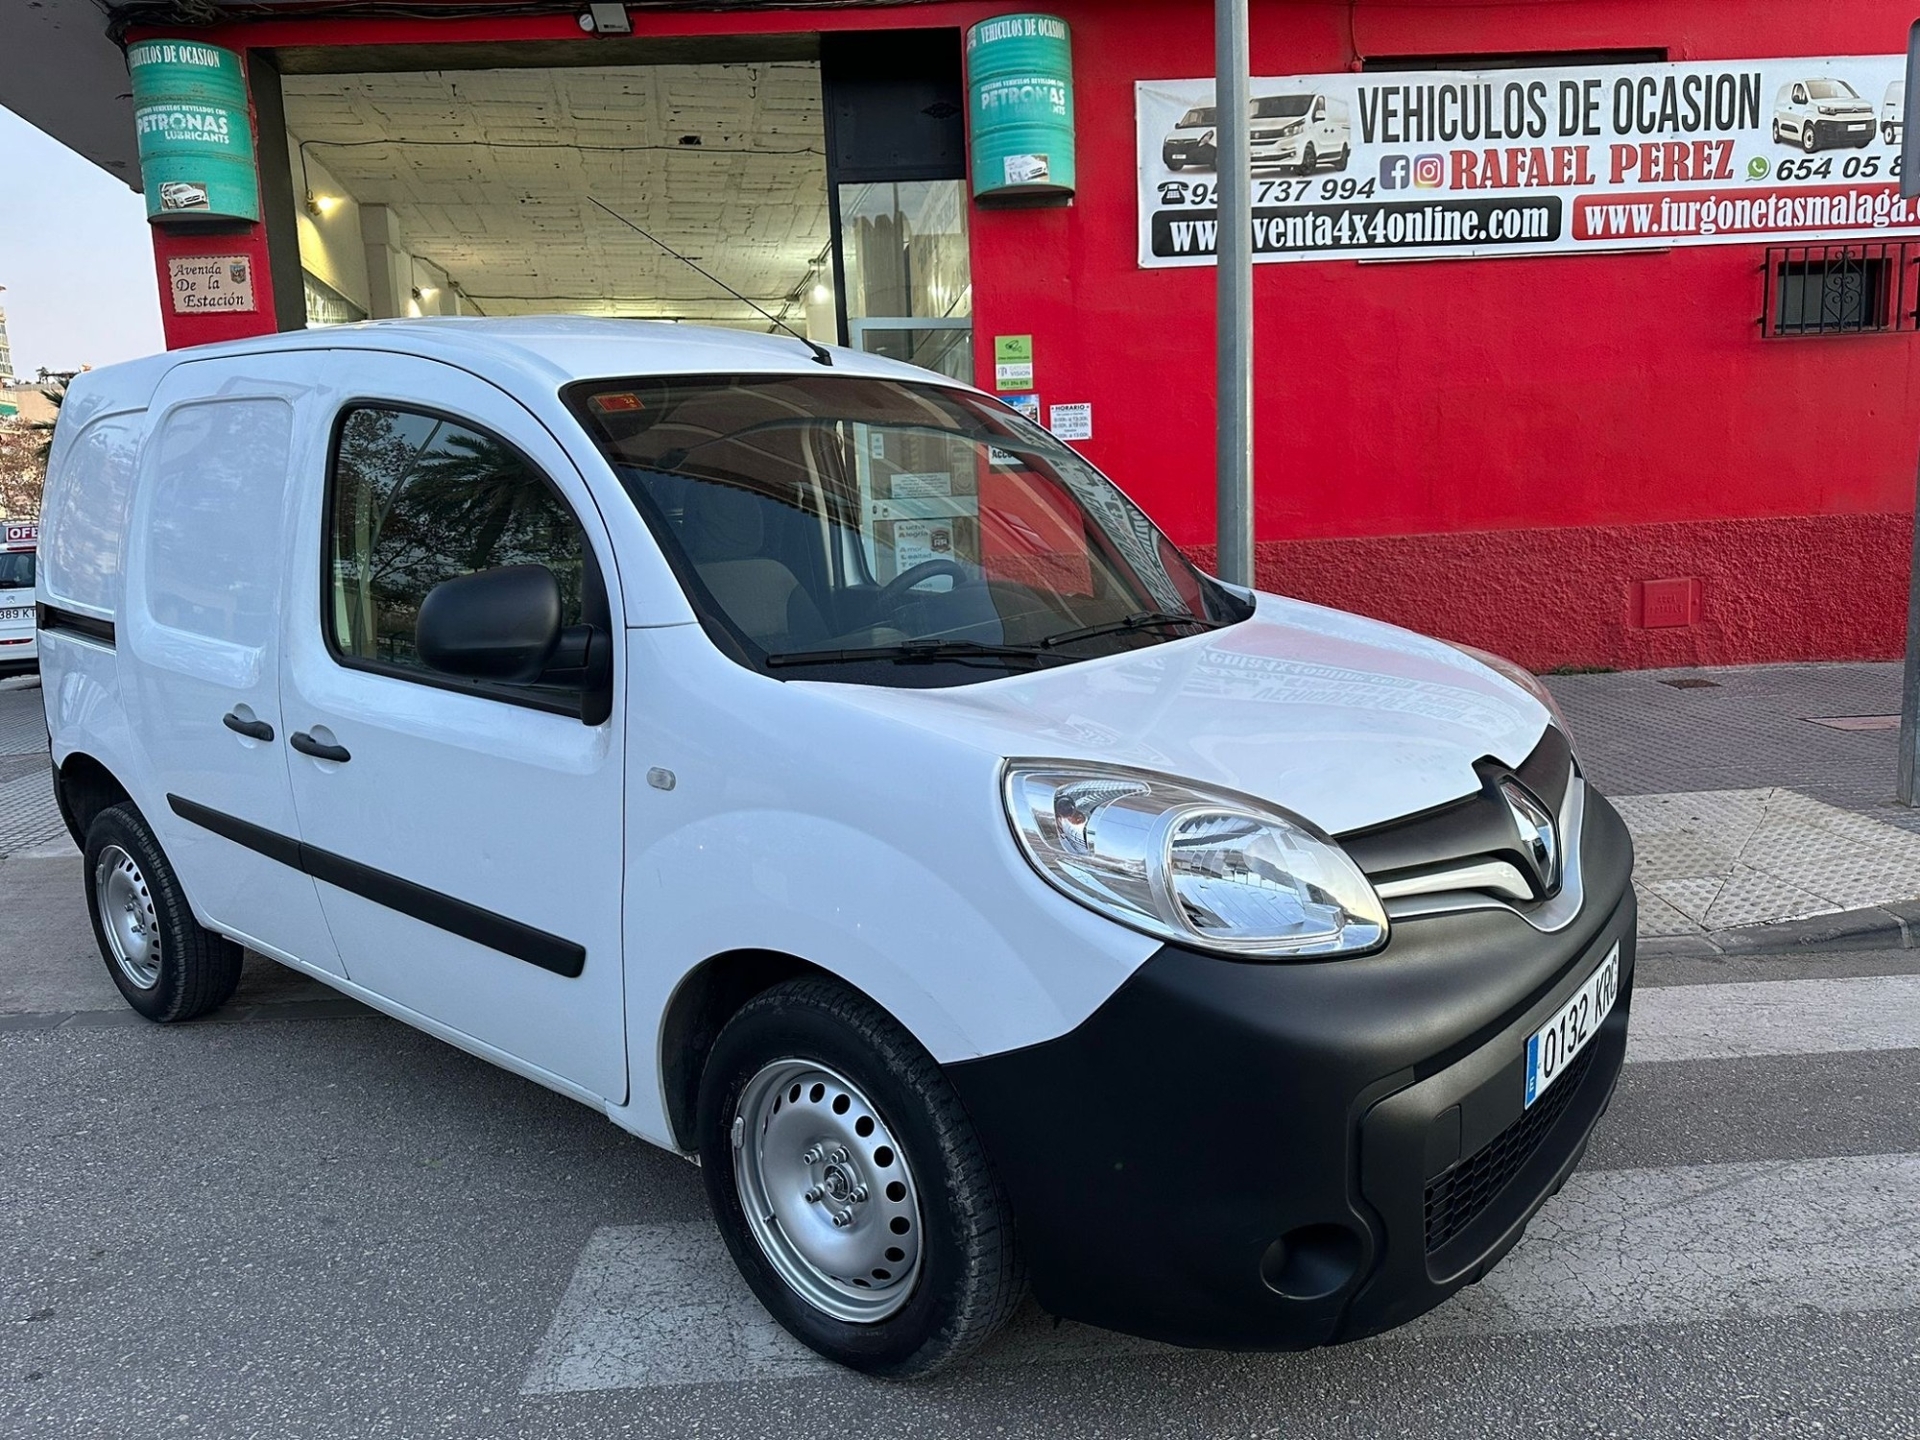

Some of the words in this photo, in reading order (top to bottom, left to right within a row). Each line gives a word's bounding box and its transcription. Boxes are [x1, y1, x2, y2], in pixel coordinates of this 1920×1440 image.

[981, 19, 1022, 44] VEHICULOS
[1024, 18, 1037, 37] DE
[1038, 19, 1065, 40] OCASION
[164, 45, 178, 64] DE
[179, 46, 220, 68] OCASION
[981, 86, 1066, 110] PETRONAS
[1357, 81, 1547, 144] VEHICULOS
[1558, 79, 1602, 137] DE
[1612, 73, 1761, 136] OCASION
[137, 112, 229, 136] PETRONAS
[165, 129, 230, 145] LUBRICANTS
[1449, 145, 1596, 190] RAFAEL
[1609, 139, 1736, 184] PEREZ
[1775, 157, 1833, 181] 654
[1842, 155, 1881, 178] 05
[1257, 180, 1313, 203] 737
[1320, 177, 1377, 201] 994
[174, 262, 222, 277] Avenida
[176, 278, 197, 291] De
[207, 275, 220, 290] la
[183, 292, 245, 307] Estación
[1543, 993, 1588, 1079] 0132
[1594, 954, 1618, 1024] KRC
